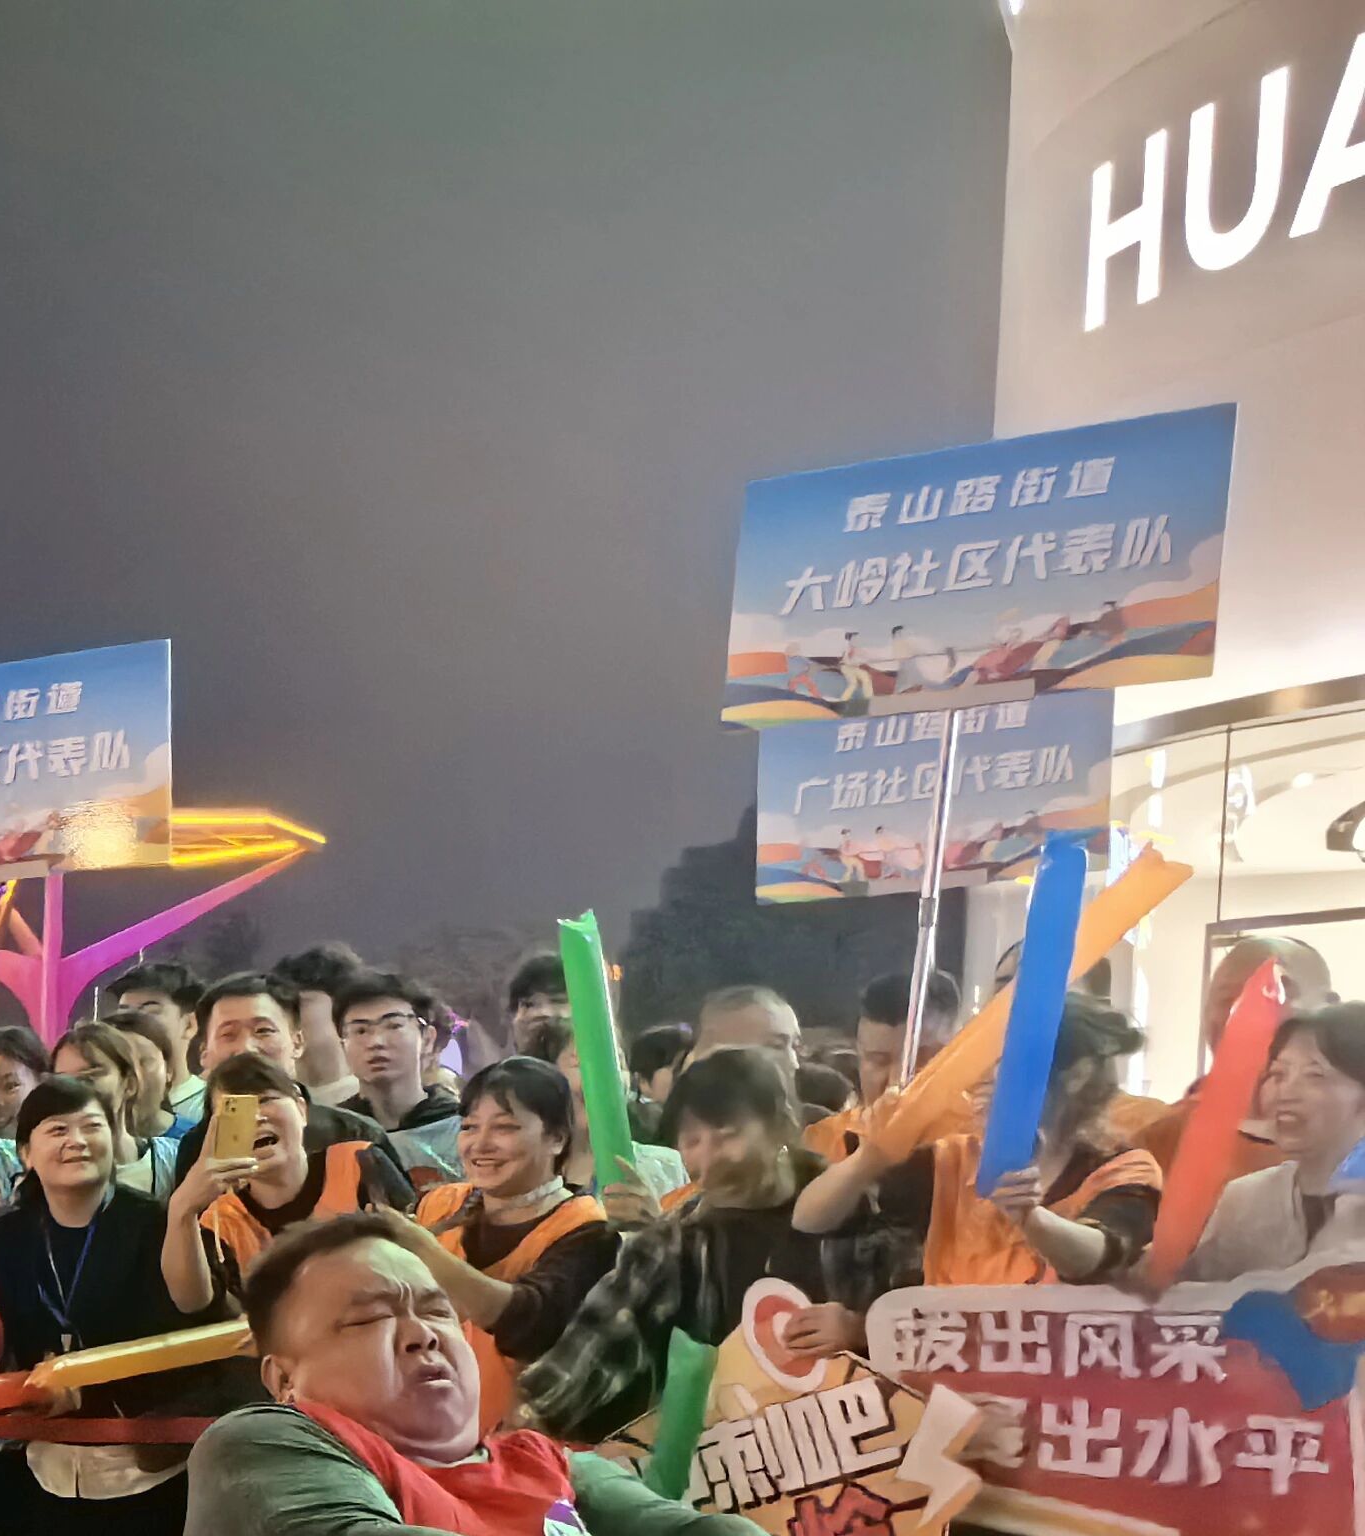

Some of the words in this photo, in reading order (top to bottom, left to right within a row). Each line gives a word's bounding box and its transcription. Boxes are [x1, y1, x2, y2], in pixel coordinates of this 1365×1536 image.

[843, 457, 1115, 532] 泰山路街道
[780, 514, 1170, 615] 大岭社区代表队
[794, 745, 1073, 815] 广场社区代表队
